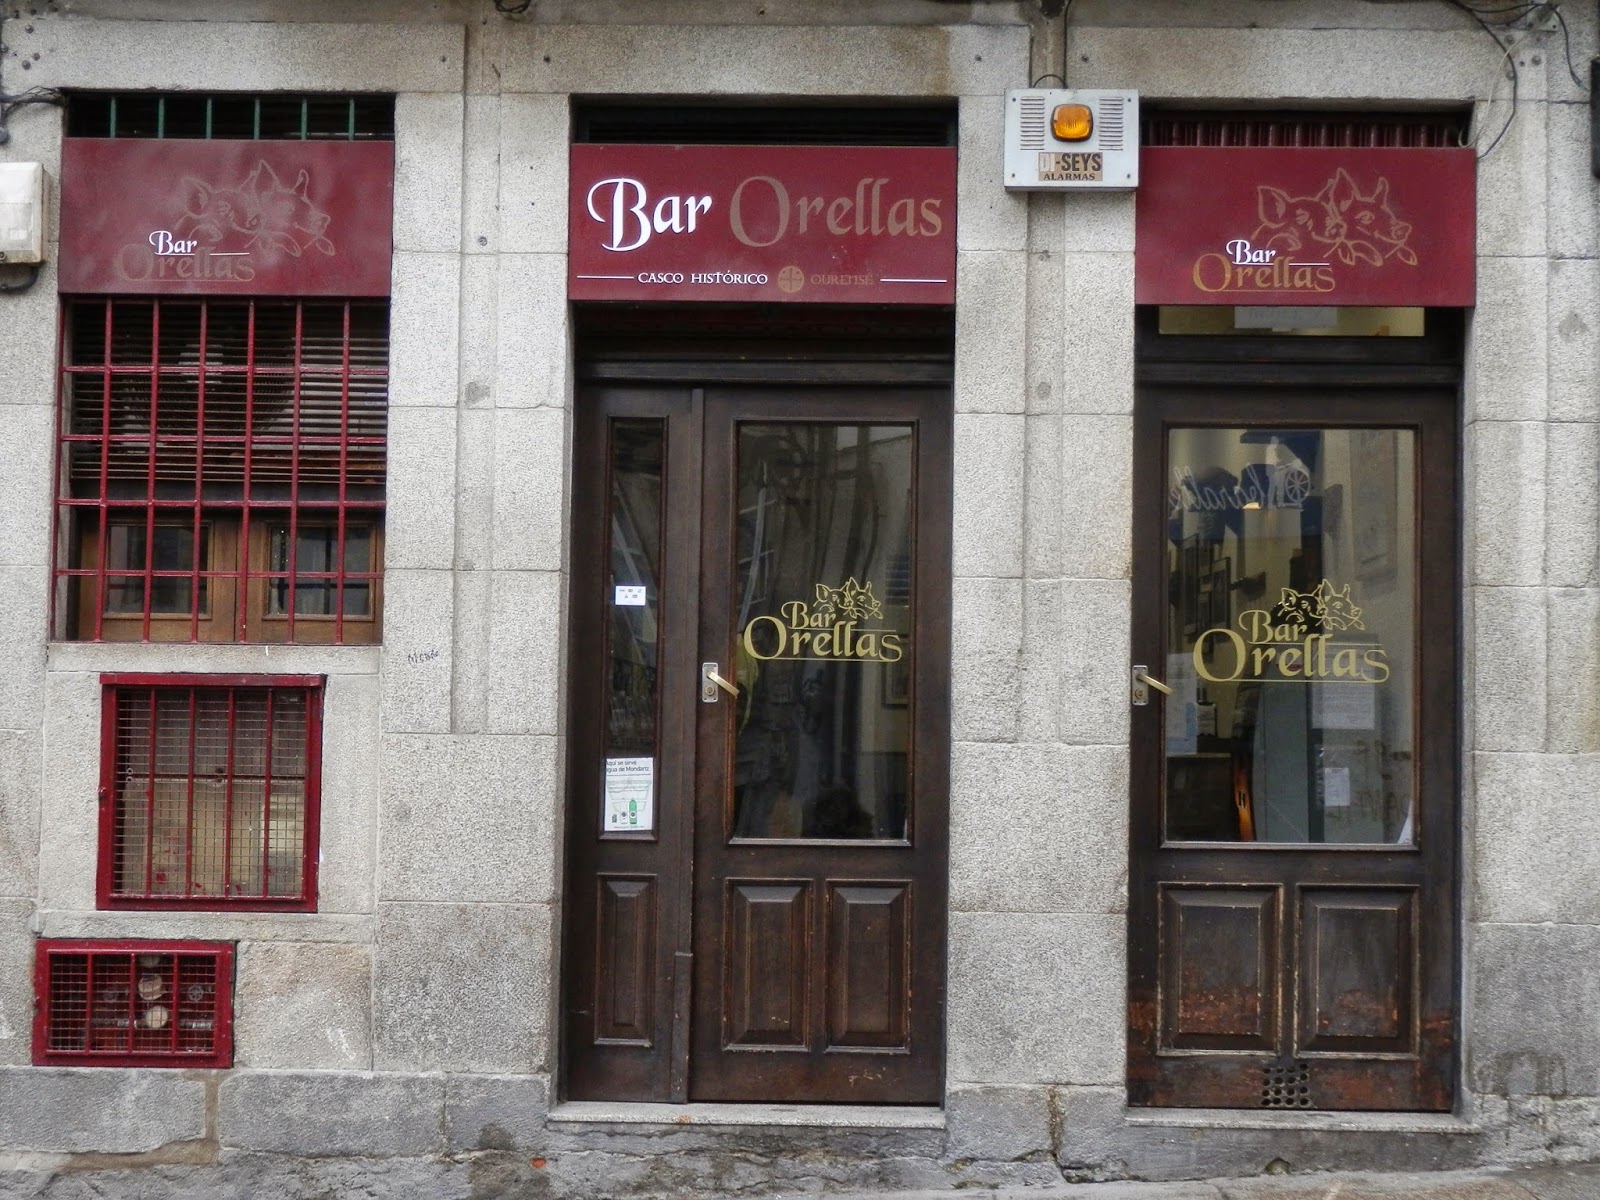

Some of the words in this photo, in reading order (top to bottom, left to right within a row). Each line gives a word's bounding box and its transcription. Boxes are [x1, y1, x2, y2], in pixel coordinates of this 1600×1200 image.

[1043, 173, 1096, 181] ALARMAS
[587, 177, 713, 252] Bar
[729, 175, 943, 247] Orellas
[148, 229, 198, 256] Bar
[1226, 239, 1276, 266] Bar
[114, 243, 255, 282] Orellas
[637, 271, 684, 284] CASCO
[690, 269, 769, 285] HISTÓRICO
[1192, 252, 1335, 293] Orellas
[781, 601, 836, 629] Bar
[1238, 609, 1308, 644] Bar
[743, 615, 903, 663] Orellas
[1193, 628, 1390, 684] Orellas
